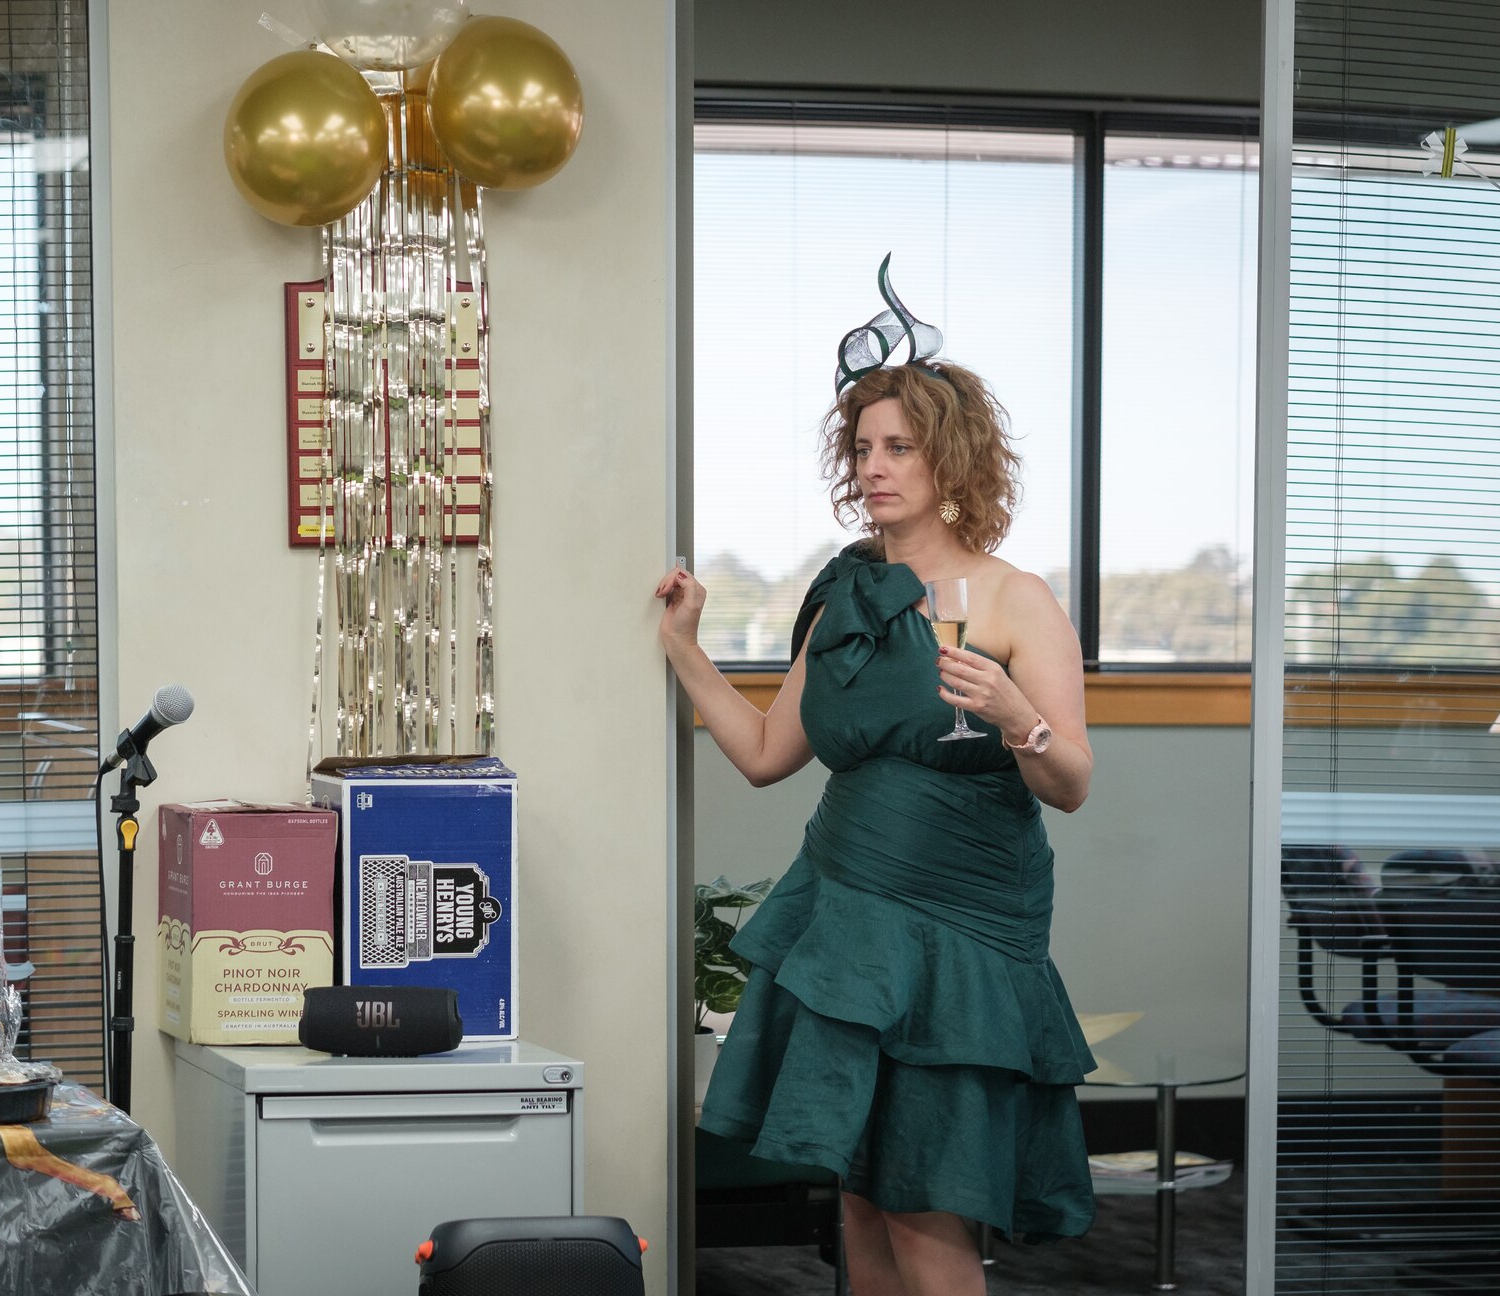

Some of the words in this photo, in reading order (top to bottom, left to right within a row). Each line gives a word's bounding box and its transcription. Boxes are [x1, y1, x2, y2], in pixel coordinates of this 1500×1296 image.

[219, 881, 261, 889] GRANT
[266, 881, 308, 889] BURGE
[395, 875, 404, 916] AUSTRALIAN
[416, 879, 427, 940] NEWTOWNER
[436, 878, 454, 943] HENRYS
[456, 882, 474, 939] YOUNG
[395, 917, 404, 934] PALE
[395, 935, 404, 949] ALE
[223, 969, 263, 979] PINOT
[267, 968, 301, 978] NOIR
[214, 983, 308, 993] CHARDONNAY
[217, 1009, 275, 1018] SPARKLING
[356, 1001, 400, 1028] JBL
